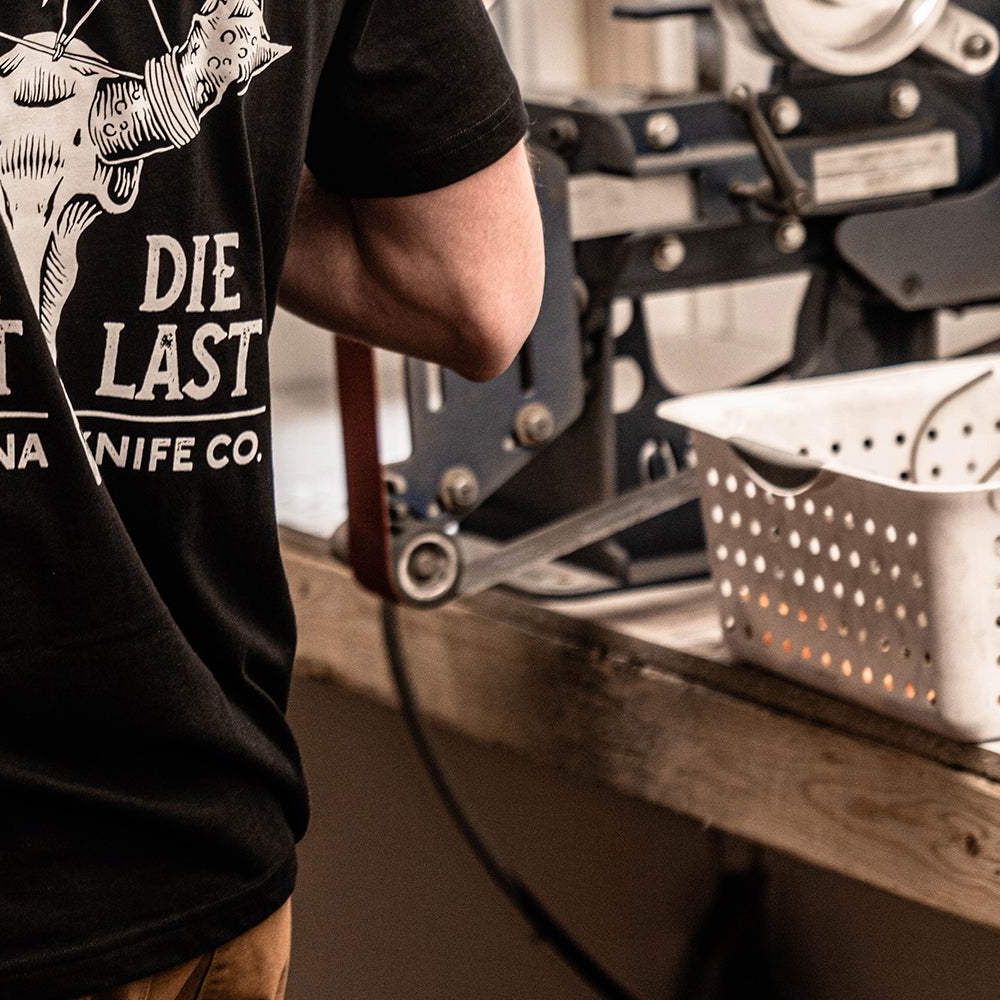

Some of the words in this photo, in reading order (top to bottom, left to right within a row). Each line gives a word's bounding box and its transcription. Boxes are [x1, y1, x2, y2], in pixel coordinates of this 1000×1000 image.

[138, 231, 241, 313] DIE
[94, 318, 263, 401] LAST
[206, 430, 263, 470] CO.
